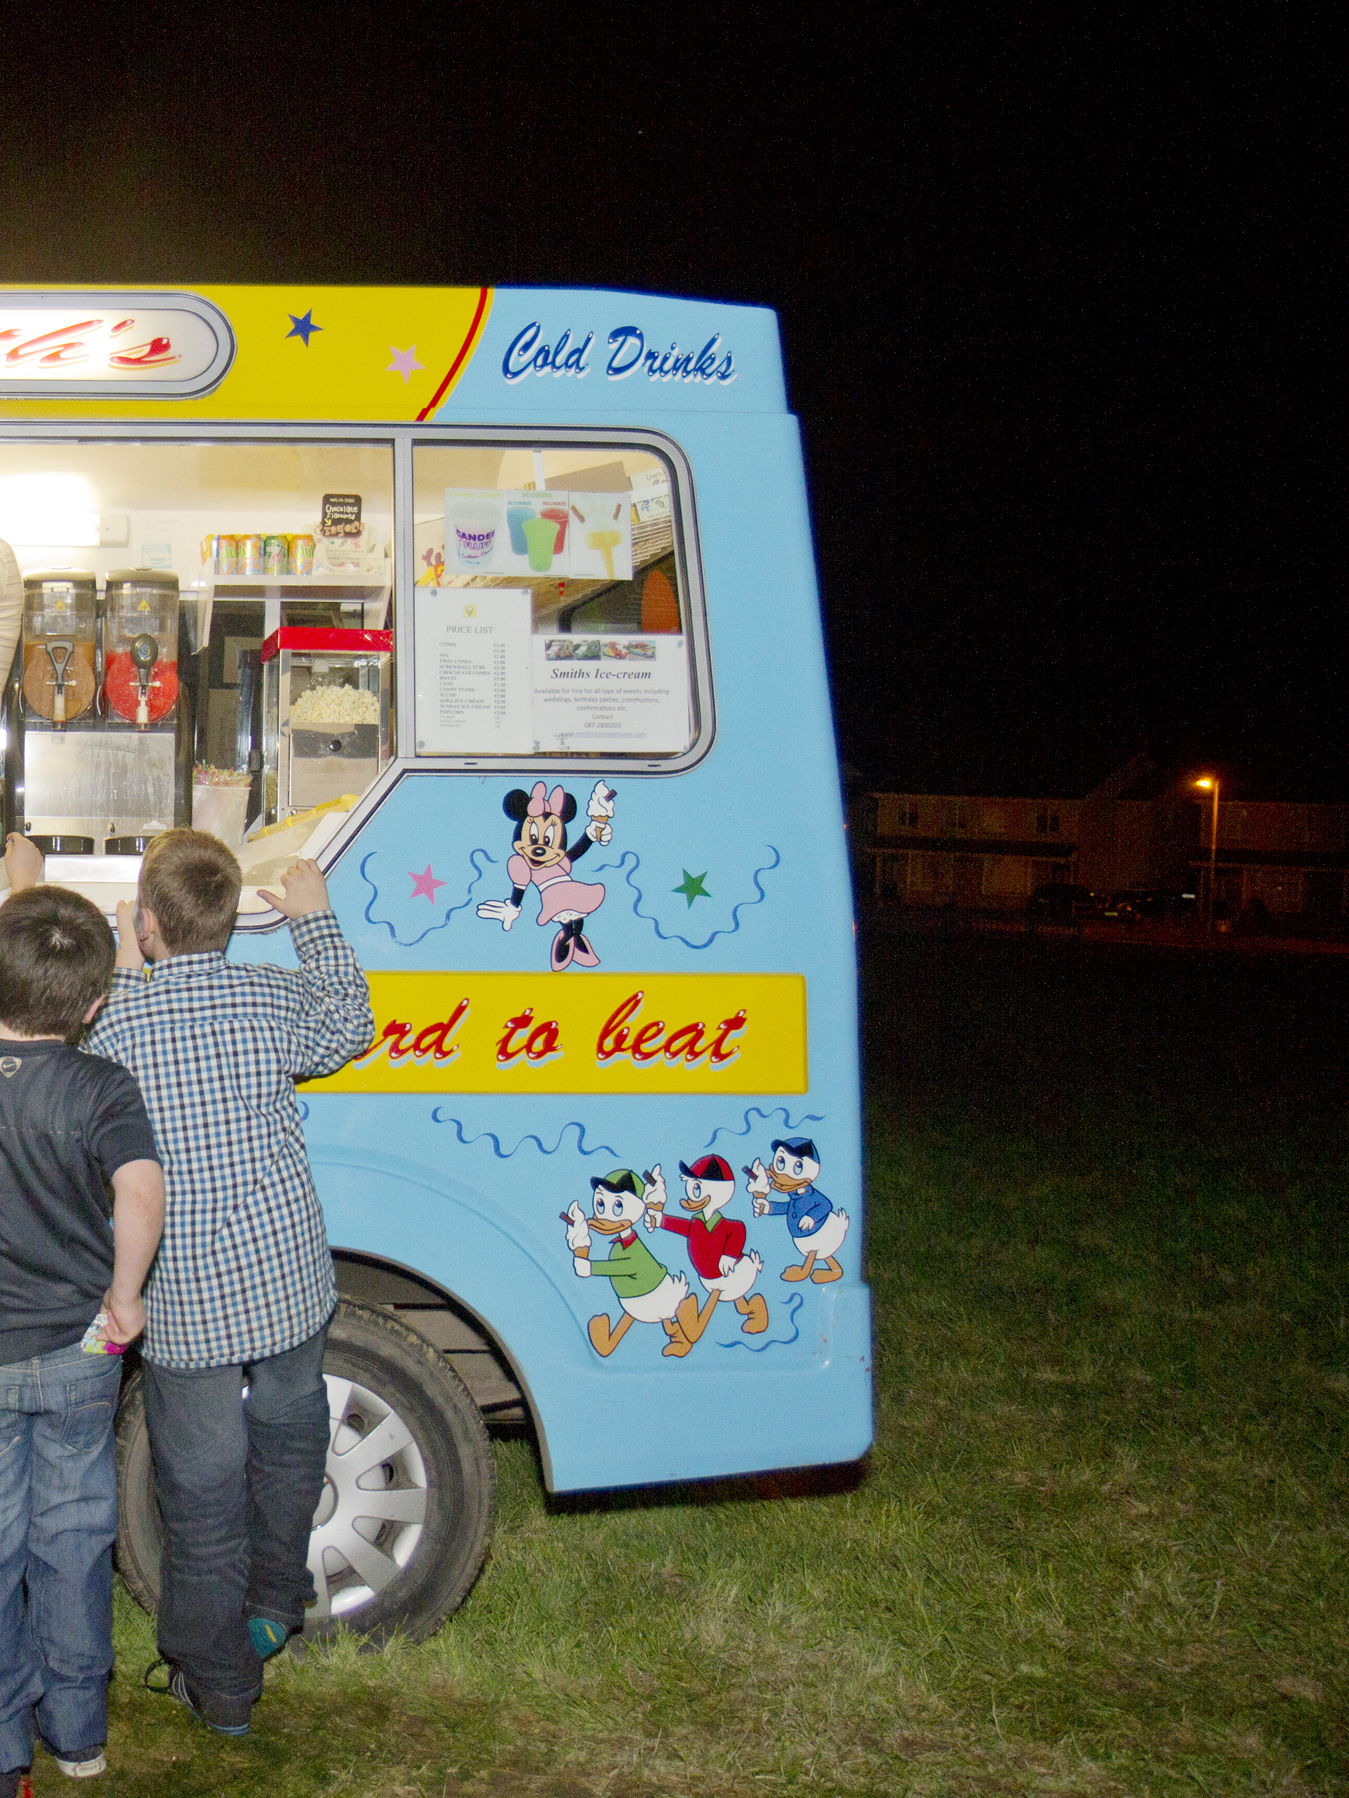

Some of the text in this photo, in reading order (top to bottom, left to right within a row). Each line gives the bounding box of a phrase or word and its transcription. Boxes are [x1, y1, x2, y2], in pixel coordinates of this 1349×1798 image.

[502, 321, 737, 384] Cold Drinks
[325, 504, 358, 514] Chocolate
[446, 626, 494, 634] PRICE LIST
[550, 668, 652, 679] Smiths Ice-cream
[353, 990, 748, 1070] rd to beat
